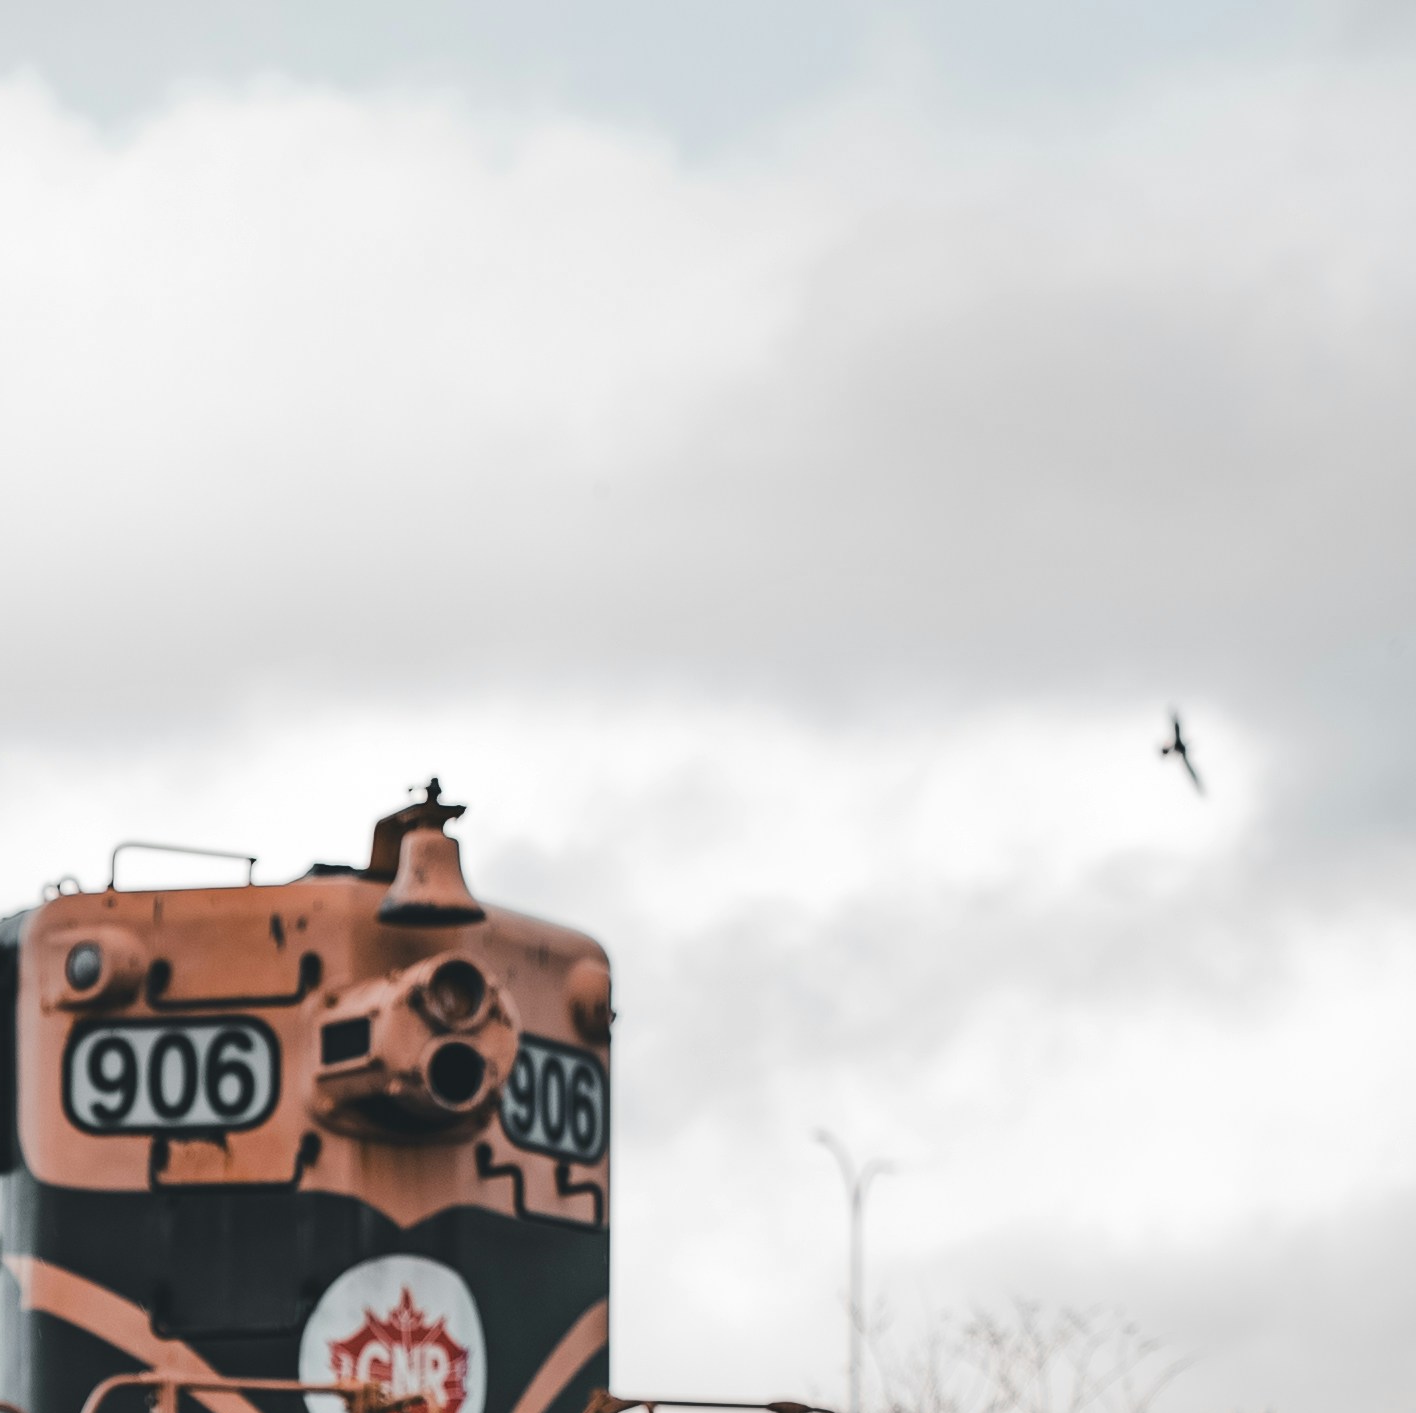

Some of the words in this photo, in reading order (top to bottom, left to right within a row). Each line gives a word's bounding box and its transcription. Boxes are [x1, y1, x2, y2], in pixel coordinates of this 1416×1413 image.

[89, 1030, 255, 1120] 906
[509, 1048, 596, 1151] 906
[356, 1340, 451, 1408] CNR
